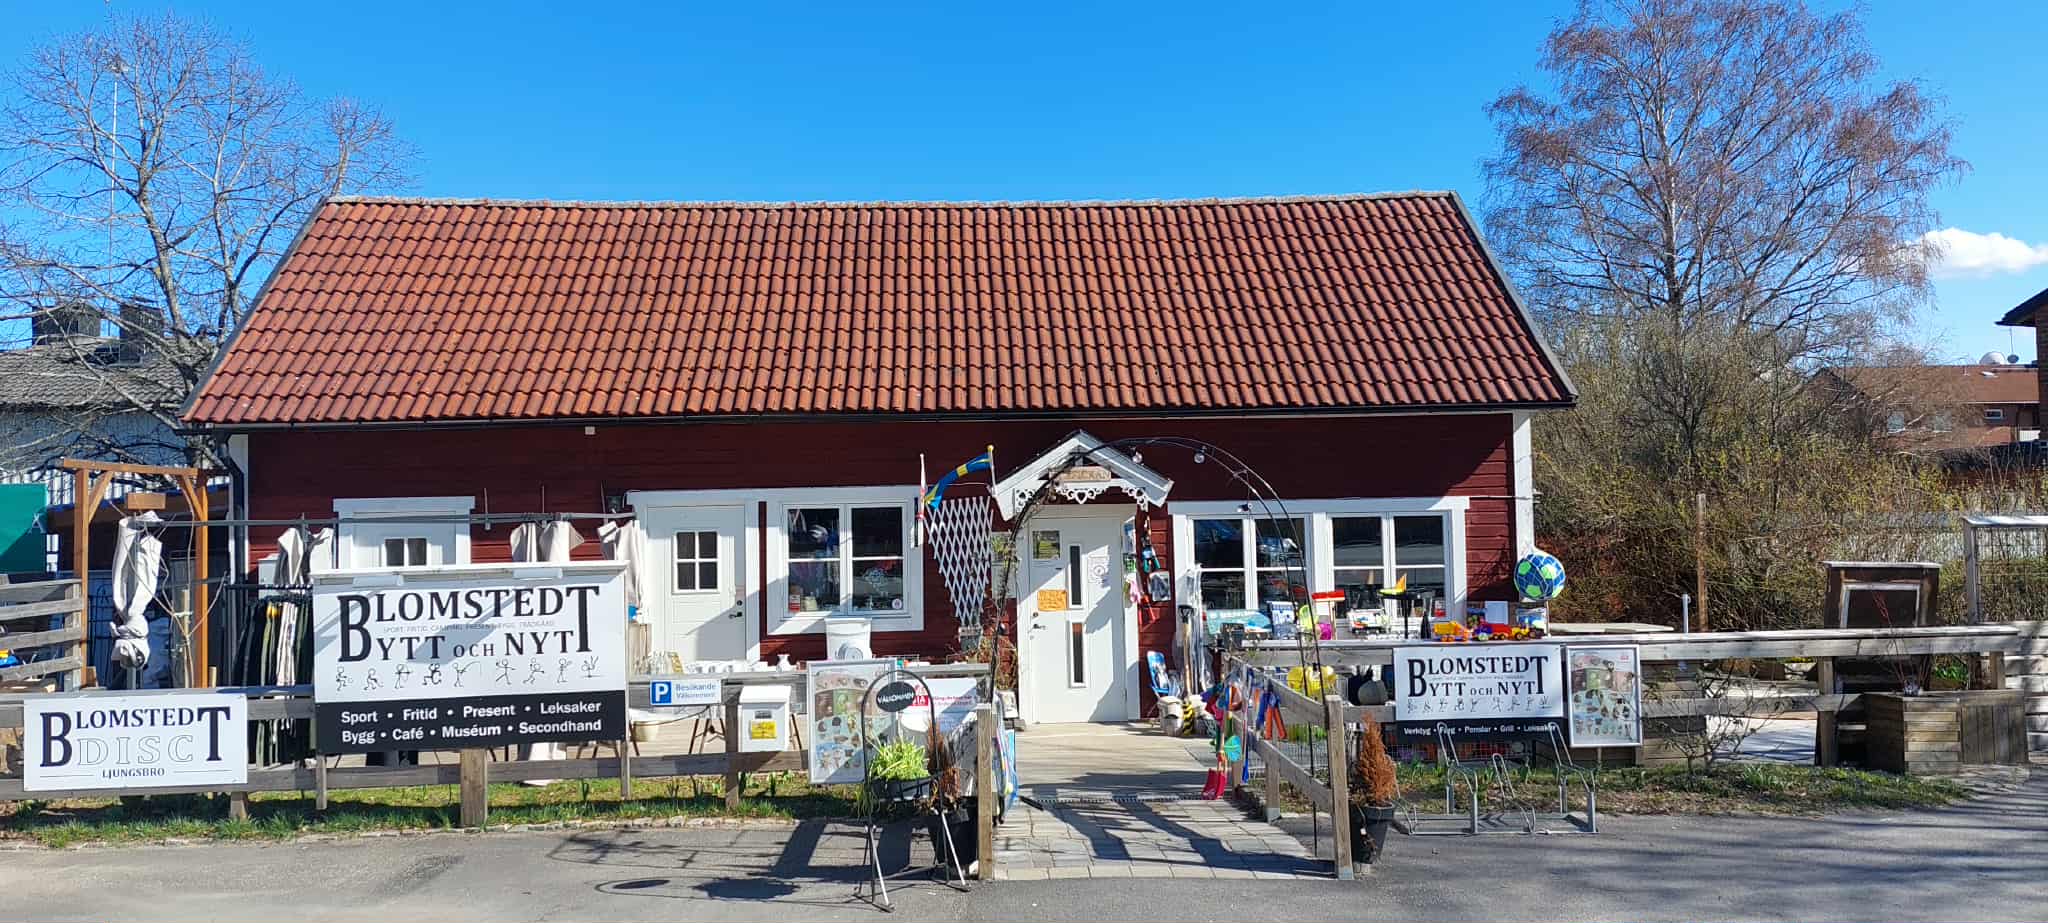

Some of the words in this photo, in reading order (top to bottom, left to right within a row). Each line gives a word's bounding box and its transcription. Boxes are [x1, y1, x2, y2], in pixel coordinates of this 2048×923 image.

[337, 586, 600, 662] BLOMSTEDT
[453, 643, 495, 657] OCH
[1407, 655, 1549, 697] BLOMSTEDT
[655, 683, 669, 702] P
[1470, 687, 1493, 696] OCH
[341, 711, 378, 725] Sport
[403, 708, 438, 721] Fritid
[463, 705, 516, 718] Present
[540, 701, 602, 715] Leksaker
[40, 706, 231, 767] BLOMSTEDT
[342, 730, 375, 745] Bygg
[392, 727, 424, 740] Café
[442, 724, 501, 739] Muséum
[519, 719, 602, 735] Secondhand
[77, 735, 193, 766] DISC
[102, 768, 165, 779] LJUNGSBRO
